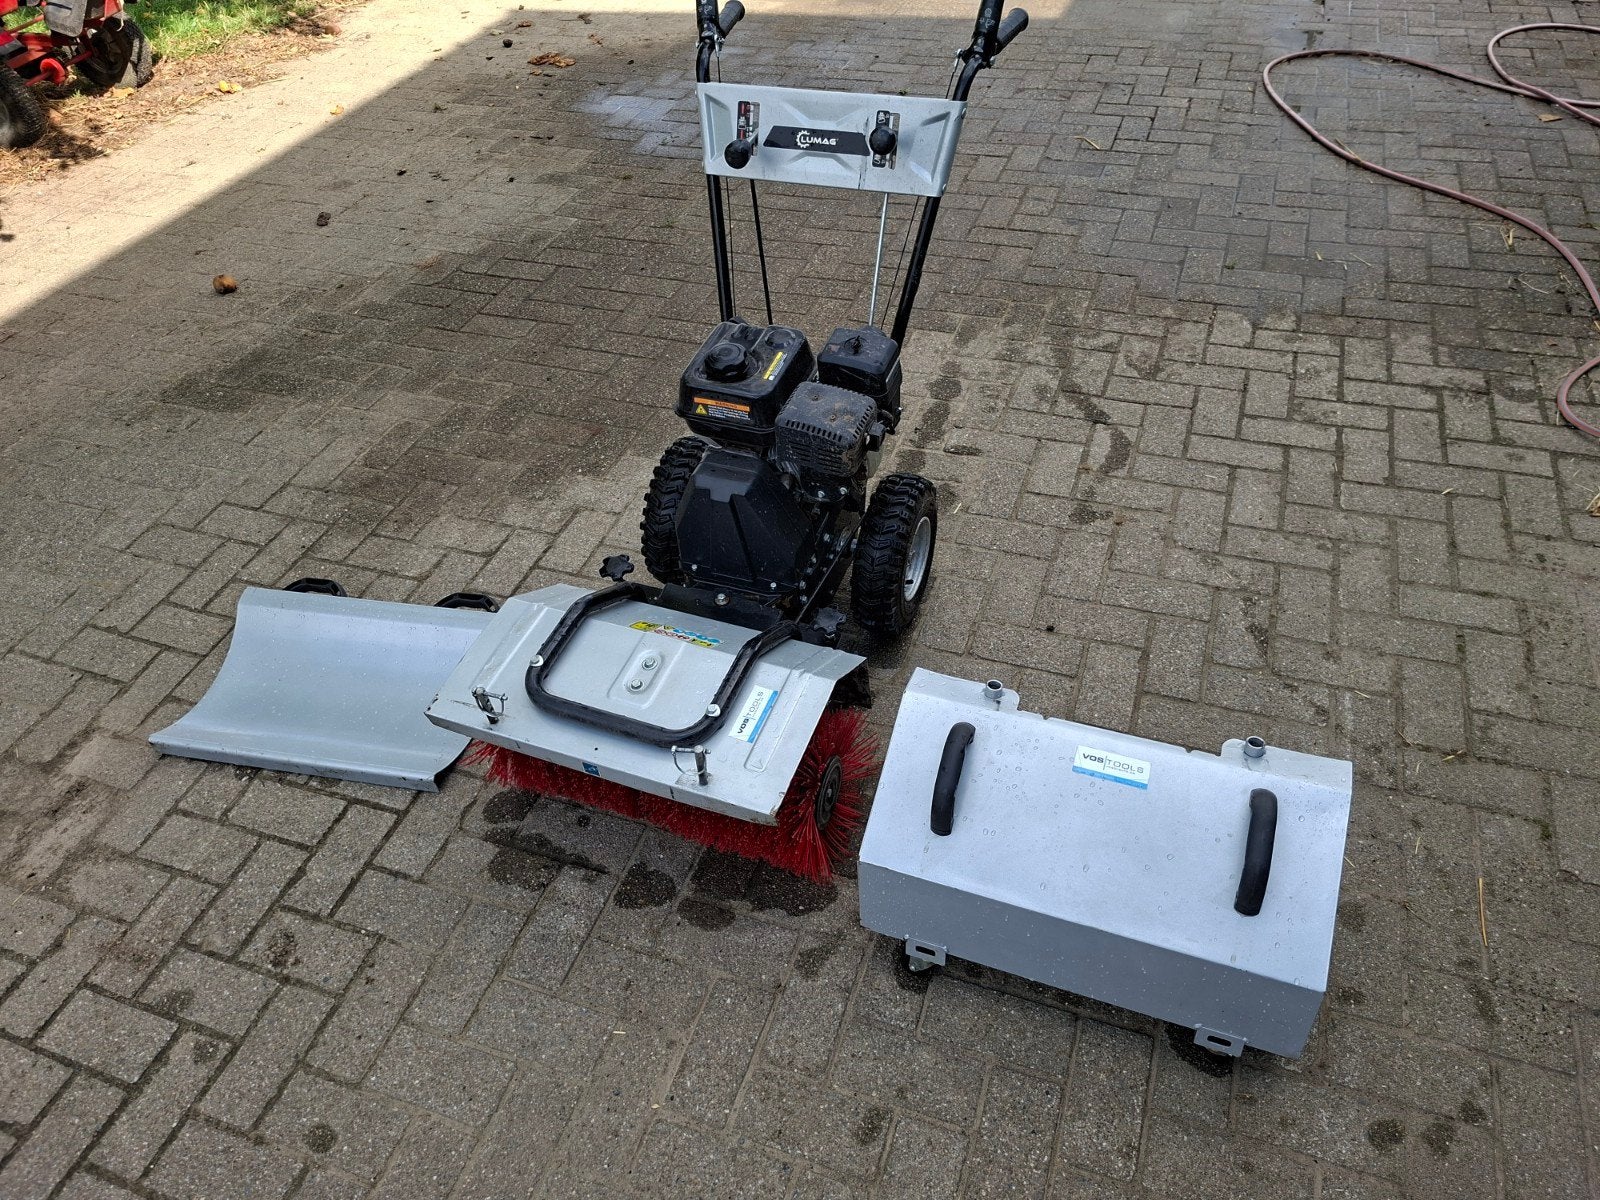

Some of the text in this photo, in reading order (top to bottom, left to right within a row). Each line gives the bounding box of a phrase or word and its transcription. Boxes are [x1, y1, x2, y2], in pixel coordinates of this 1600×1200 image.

[800, 136, 837, 146] LUMAG
[737, 718, 750, 734] VOS
[746, 691, 764, 717] TOOLS
[1082, 752, 1104, 764] VOS
[1106, 758, 1144, 774] TOOLS
